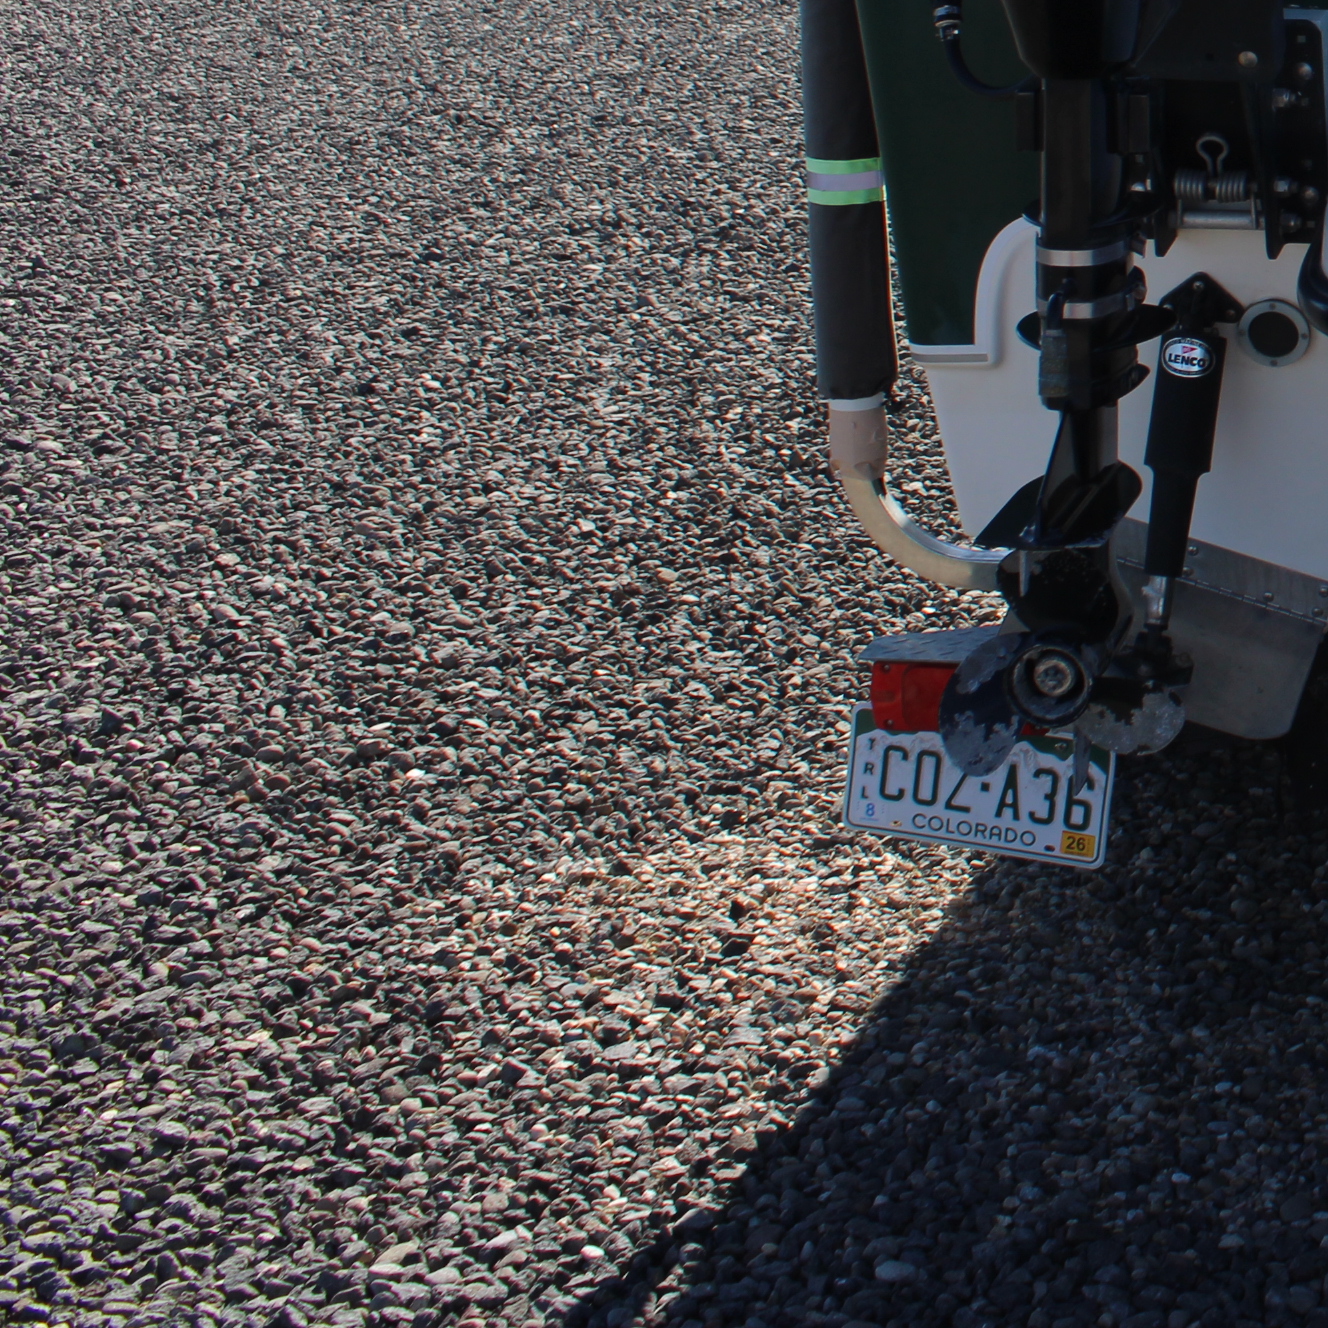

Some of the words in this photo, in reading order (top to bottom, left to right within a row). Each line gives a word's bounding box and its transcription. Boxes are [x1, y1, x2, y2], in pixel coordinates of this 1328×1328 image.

[1168, 353, 1207, 369] LENCO
[865, 802, 875, 817] 8
[911, 812, 1037, 847] COLORADO
[1065, 835, 1087, 852] 26
